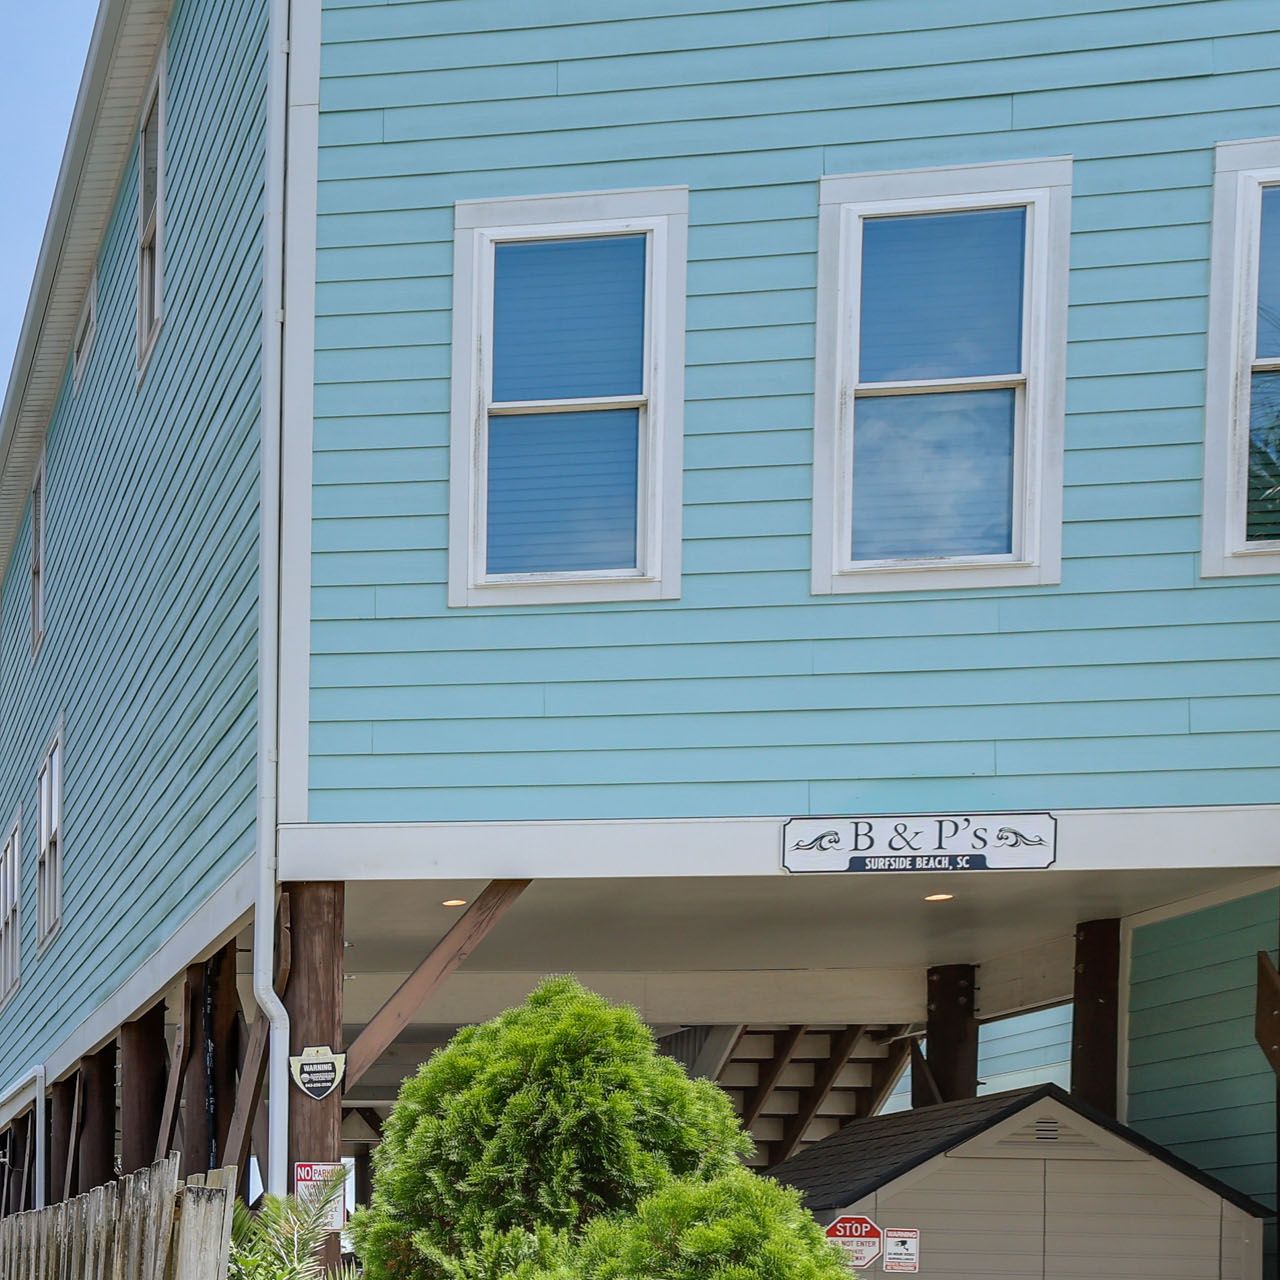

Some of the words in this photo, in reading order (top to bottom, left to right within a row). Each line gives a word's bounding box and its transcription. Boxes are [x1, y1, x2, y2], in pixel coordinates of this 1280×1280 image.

[849, 821, 875, 852] B
[887, 822, 925, 851] &
[932, 818, 989, 851] P's
[865, 857, 912, 870] SURFSIDE
[915, 856, 954, 871] BEACH,
[957, 856, 970, 868] SC
[303, 1063, 333, 1072] WARNING
[297, 1166, 312, 1180] NO
[836, 1223, 871, 1236] STOP
